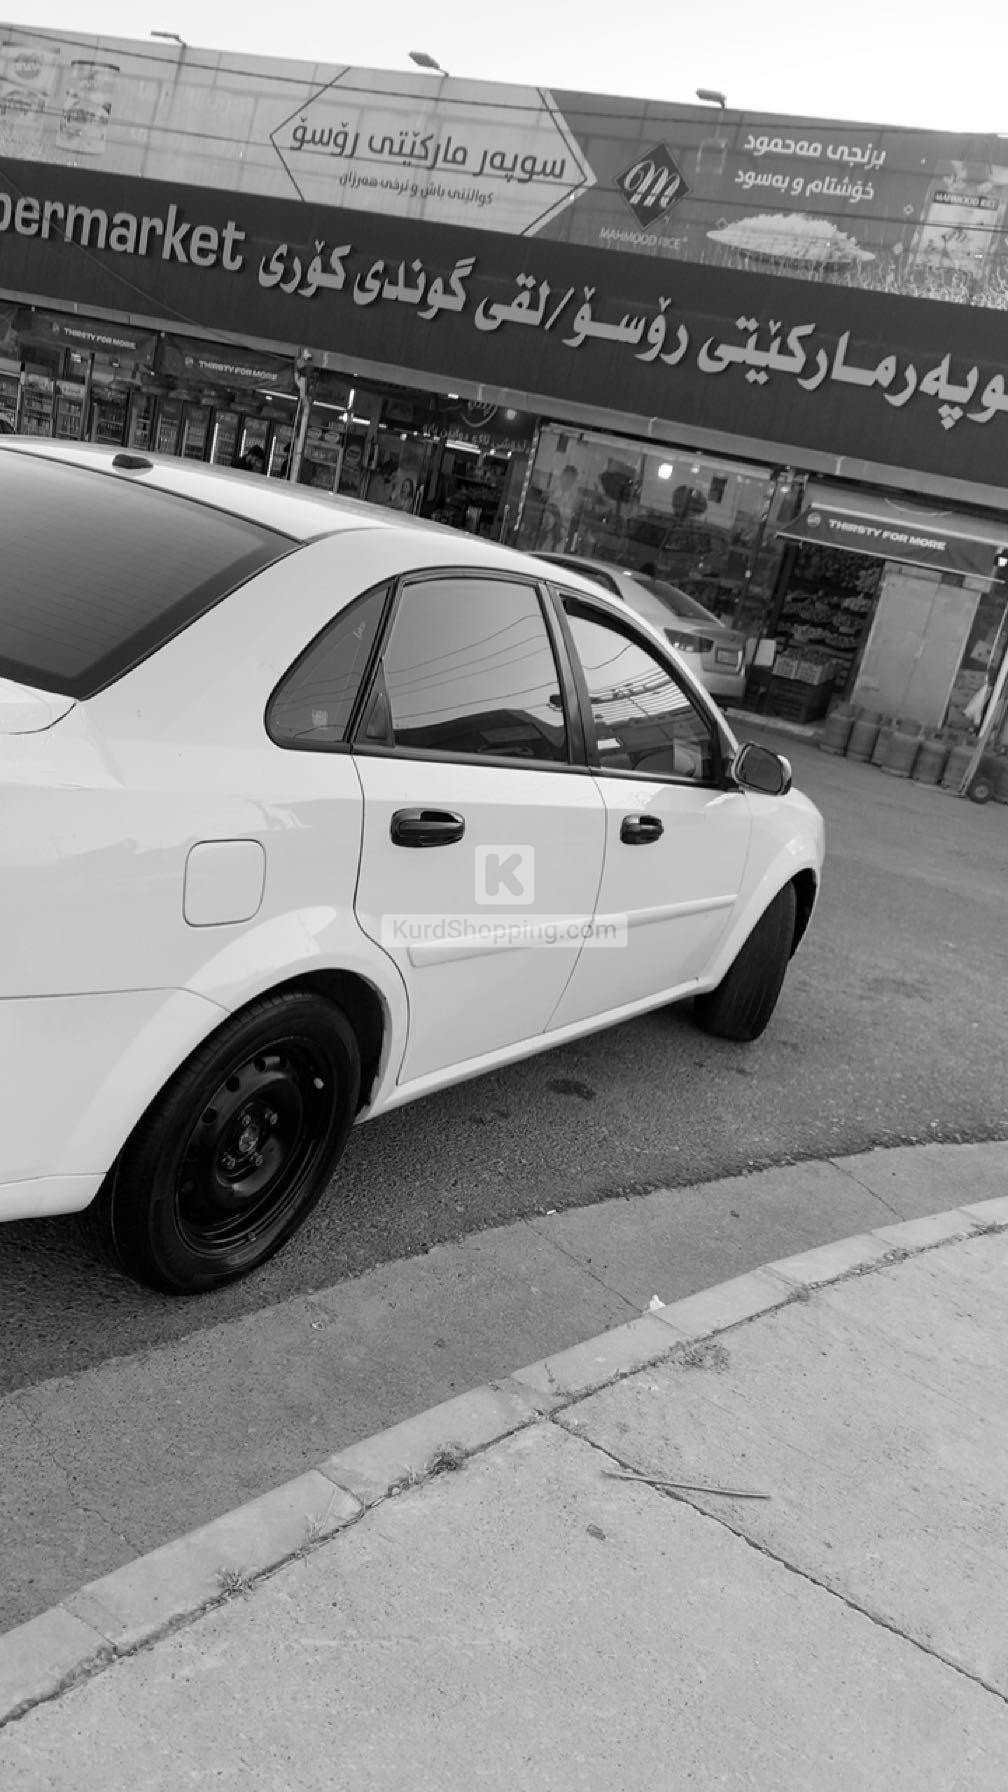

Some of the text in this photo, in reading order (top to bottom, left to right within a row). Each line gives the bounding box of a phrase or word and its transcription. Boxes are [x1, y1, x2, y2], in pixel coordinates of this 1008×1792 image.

[289, 117, 361, 159] رۆسۆ
[791, 178, 804, 195] و
[599, 227, 682, 250] MAHMOOD RICE
[353, 256, 477, 320] گوندی
[63, 327, 137, 350] THIRSTY FOR MORE
[198, 360, 278, 381] THIRSTY FOR MORE
[828, 518, 947, 551] THIRSTY FOR MORE
